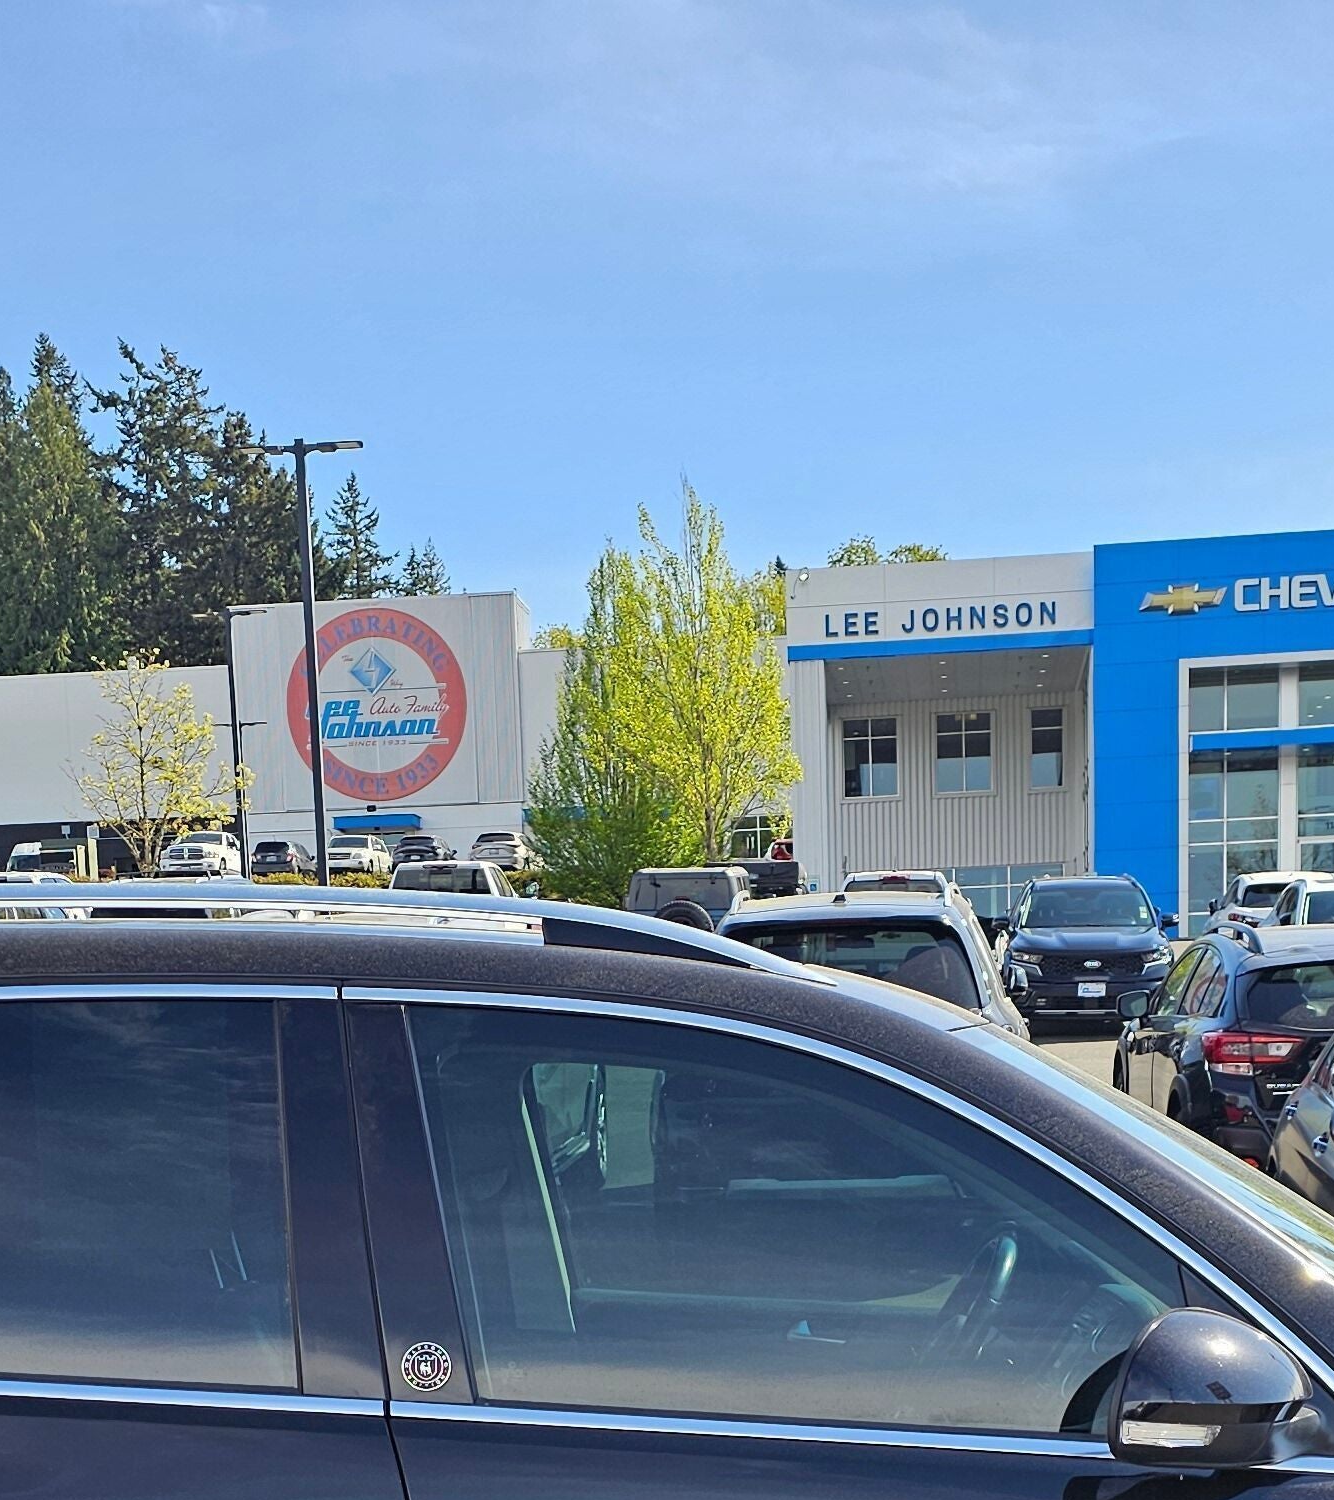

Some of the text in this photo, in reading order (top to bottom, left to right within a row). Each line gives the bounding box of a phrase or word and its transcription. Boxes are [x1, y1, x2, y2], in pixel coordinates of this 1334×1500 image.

[824, 600, 1058, 638] LEE JOHNSON
[300, 615, 449, 677] LEBRATING
[369, 694, 450, 721] Auto Family
[348, 740, 378, 748] SINCE
